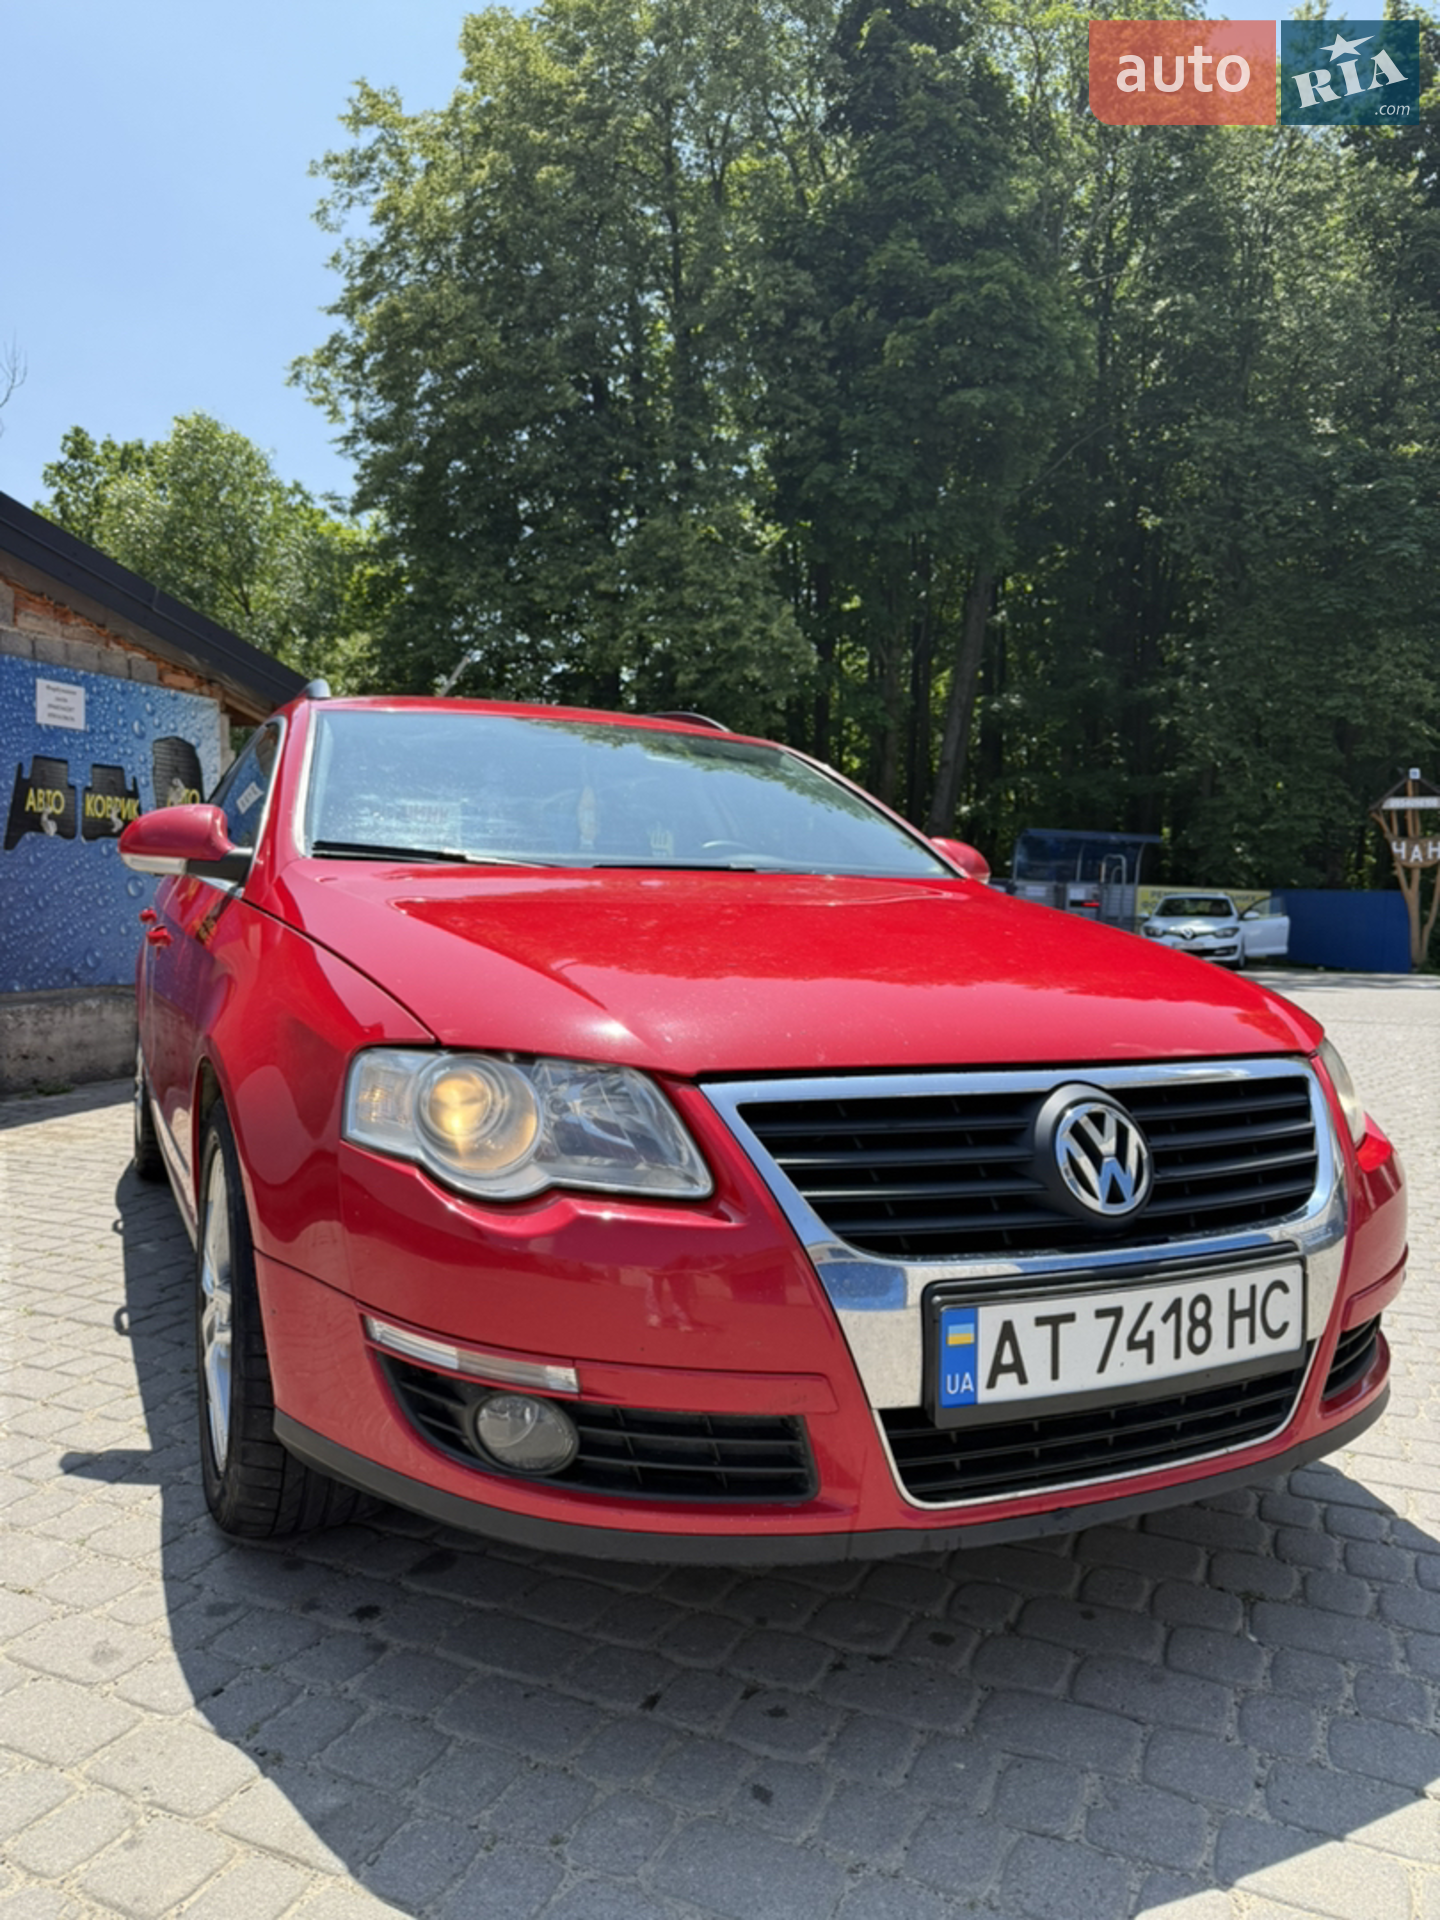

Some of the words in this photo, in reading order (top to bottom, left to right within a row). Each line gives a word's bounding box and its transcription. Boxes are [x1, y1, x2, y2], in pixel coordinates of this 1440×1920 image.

[985, 1311, 1077, 1389] AT
[1094, 1293, 1213, 1374] 7418
[1227, 1279, 1291, 1349] HC
[946, 1371, 975, 1395] UA
